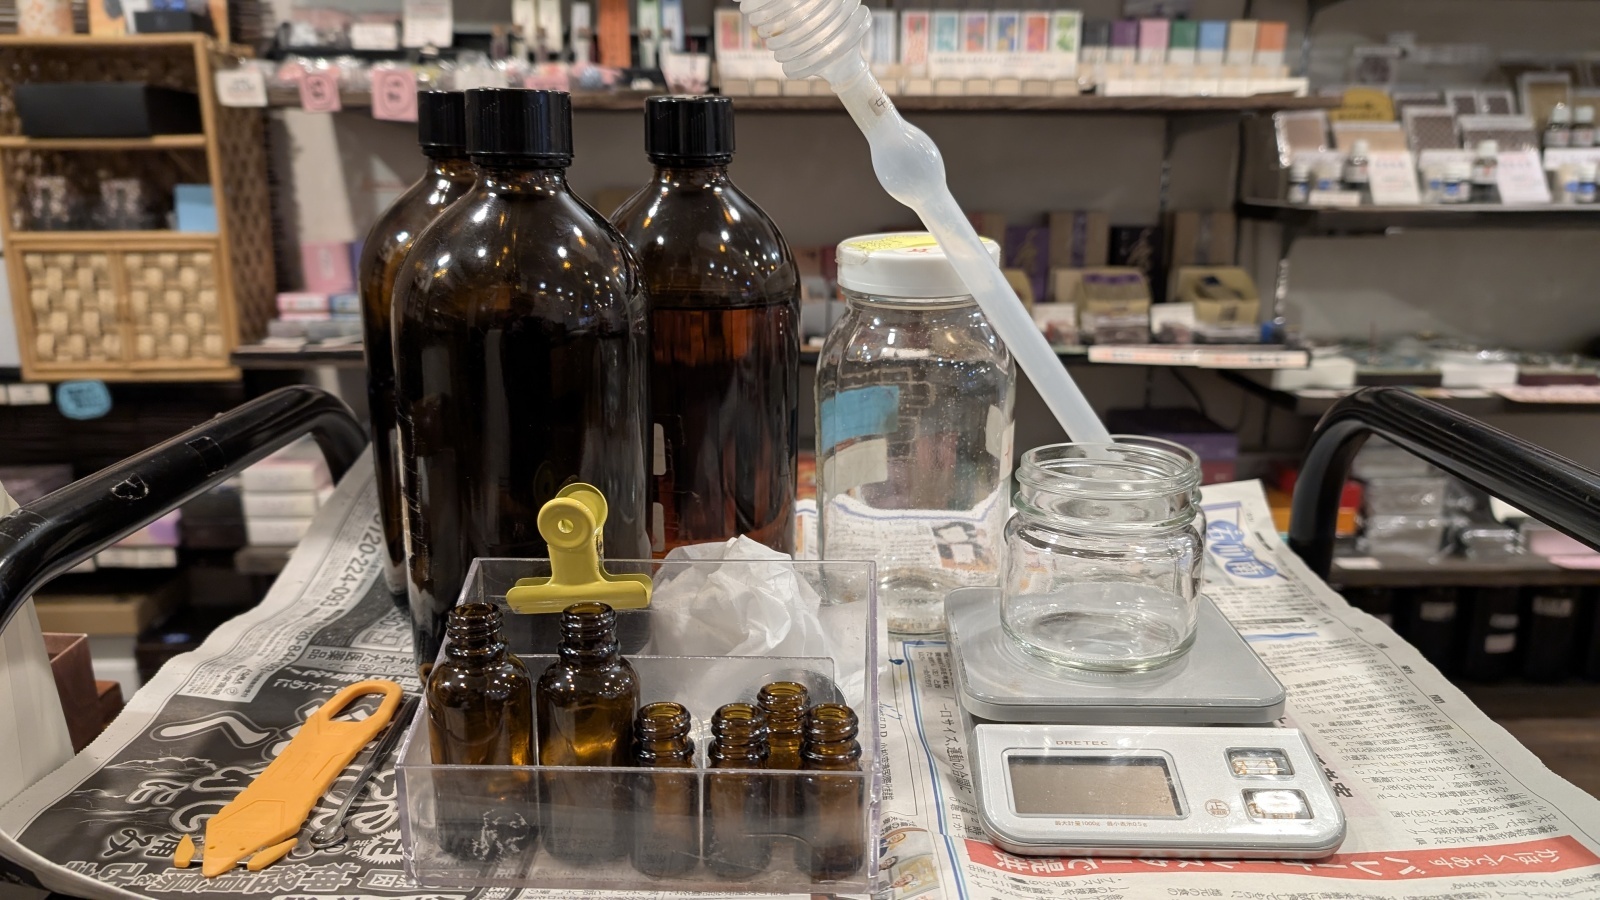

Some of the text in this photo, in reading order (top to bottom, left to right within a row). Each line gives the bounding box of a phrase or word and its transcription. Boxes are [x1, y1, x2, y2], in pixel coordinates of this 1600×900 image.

[1430, 848, 1563, 868] かほくであす
